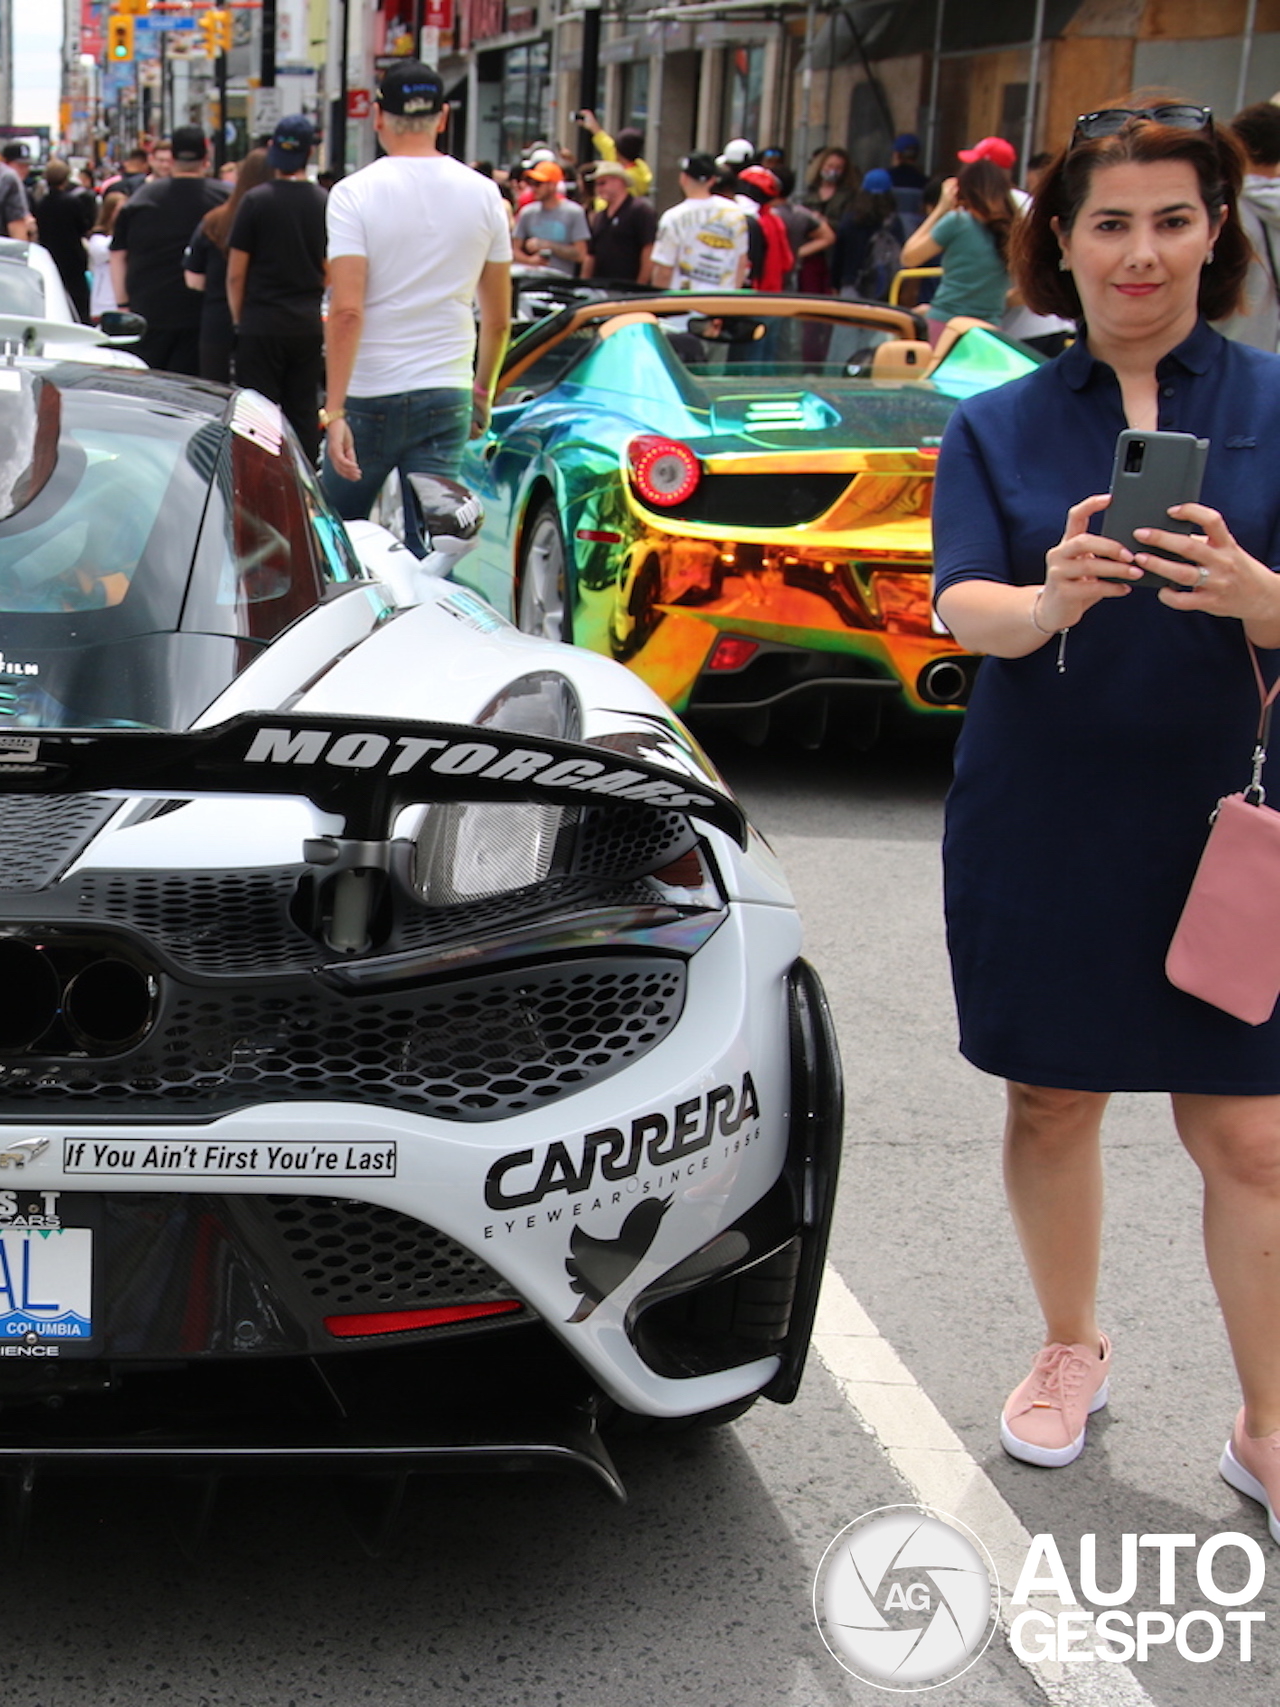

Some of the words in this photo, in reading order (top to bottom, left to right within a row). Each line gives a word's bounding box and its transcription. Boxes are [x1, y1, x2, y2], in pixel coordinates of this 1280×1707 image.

[243, 727, 717, 808] MOTORCARS
[65, 1143, 86, 1167] If
[94, 1145, 135, 1168] You
[141, 1144, 197, 1169] Ain't
[204, 1145, 259, 1170] First
[268, 1146, 338, 1170] You're
[345, 1147, 395, 1171] Last
[484, 1070, 761, 1211] CARRERA
[484, 1191, 621, 1239] EYEWEAR
[642, 1156, 710, 1193] SINCE
[723, 1126, 761, 1158] 1956
[6, 1322, 81, 1336] COLUMBIA
